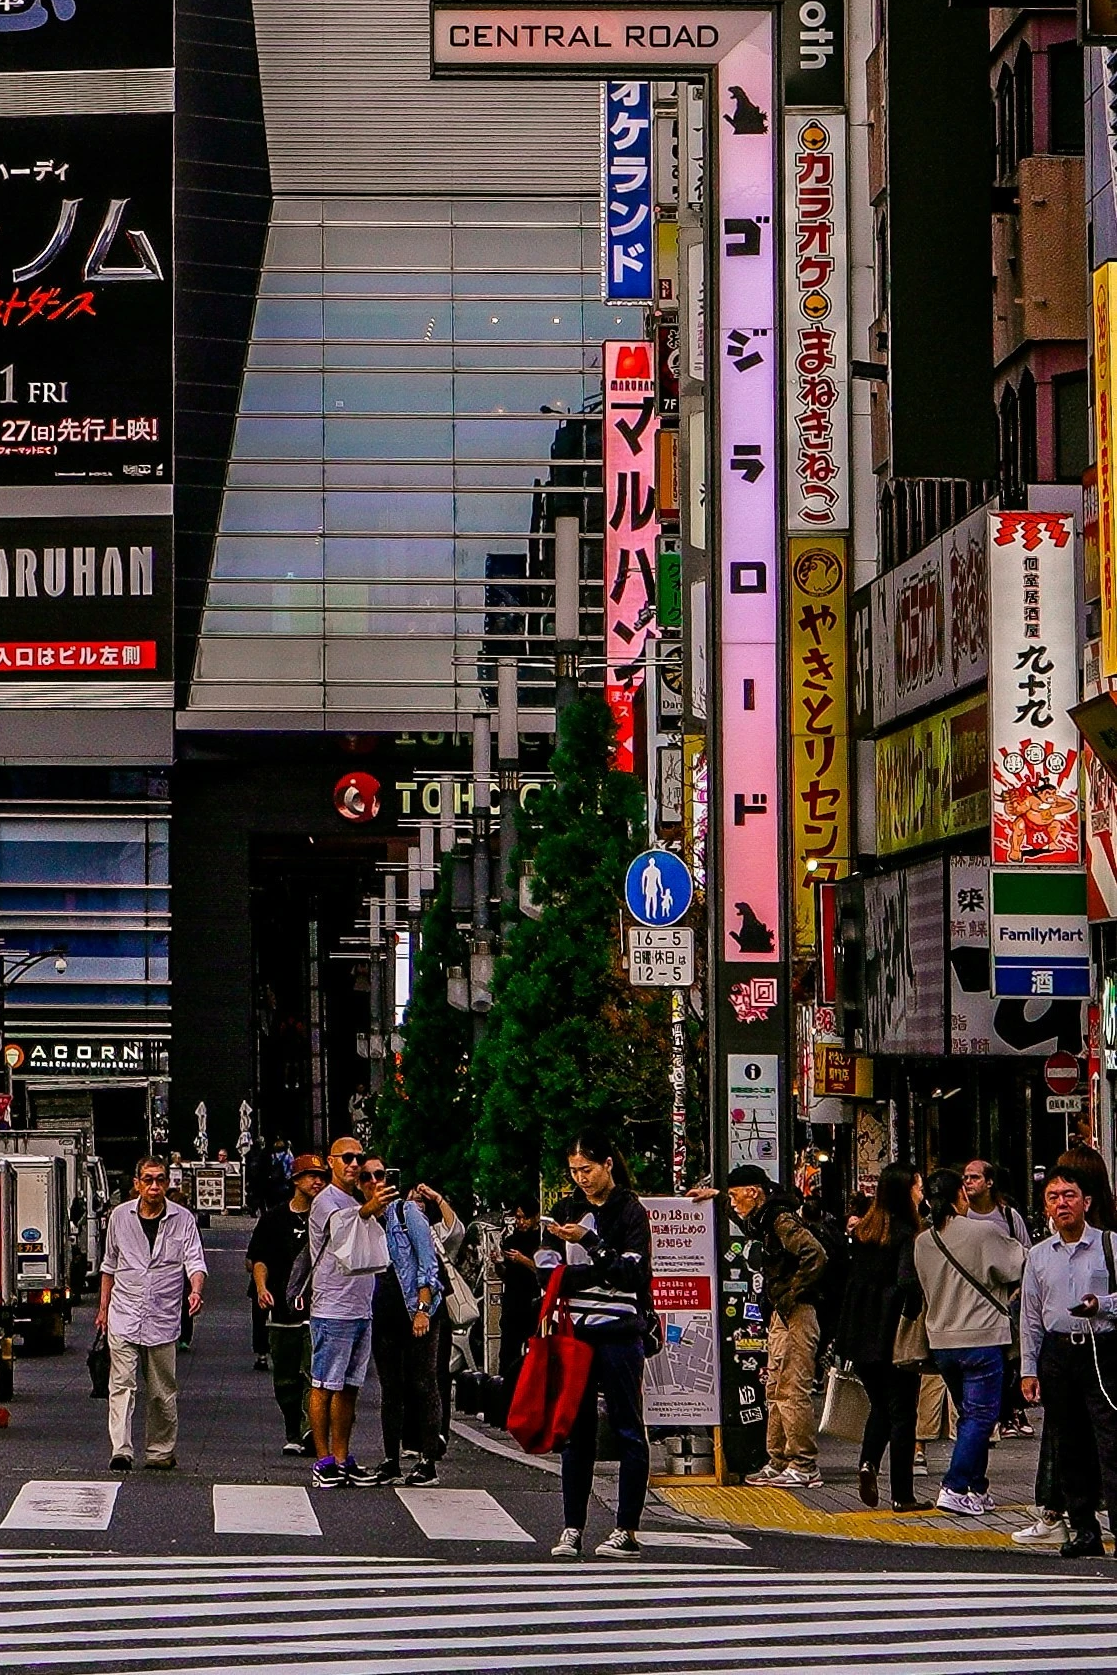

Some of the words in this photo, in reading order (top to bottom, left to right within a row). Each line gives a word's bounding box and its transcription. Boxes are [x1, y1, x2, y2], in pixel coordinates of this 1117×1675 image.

[449, 24, 613, 49] CENTRAL
[625, 24, 720, 49] ROAD
[795, 148, 839, 292] カラオケ
[27, 381, 69, 404] FRI
[663, 398, 677, 410] 7F
[794, 322, 841, 525] まねきねこ
[724, 215, 771, 826] ゴジラロード
[1012, 645, 1055, 730] 九十九
[999, 926, 1084, 945] FamilyMart
[1030, 969, 1055, 995] 酒
[31, 1045, 140, 1060] ACORN
[650, 1225, 706, 1235] 両通行止めの
